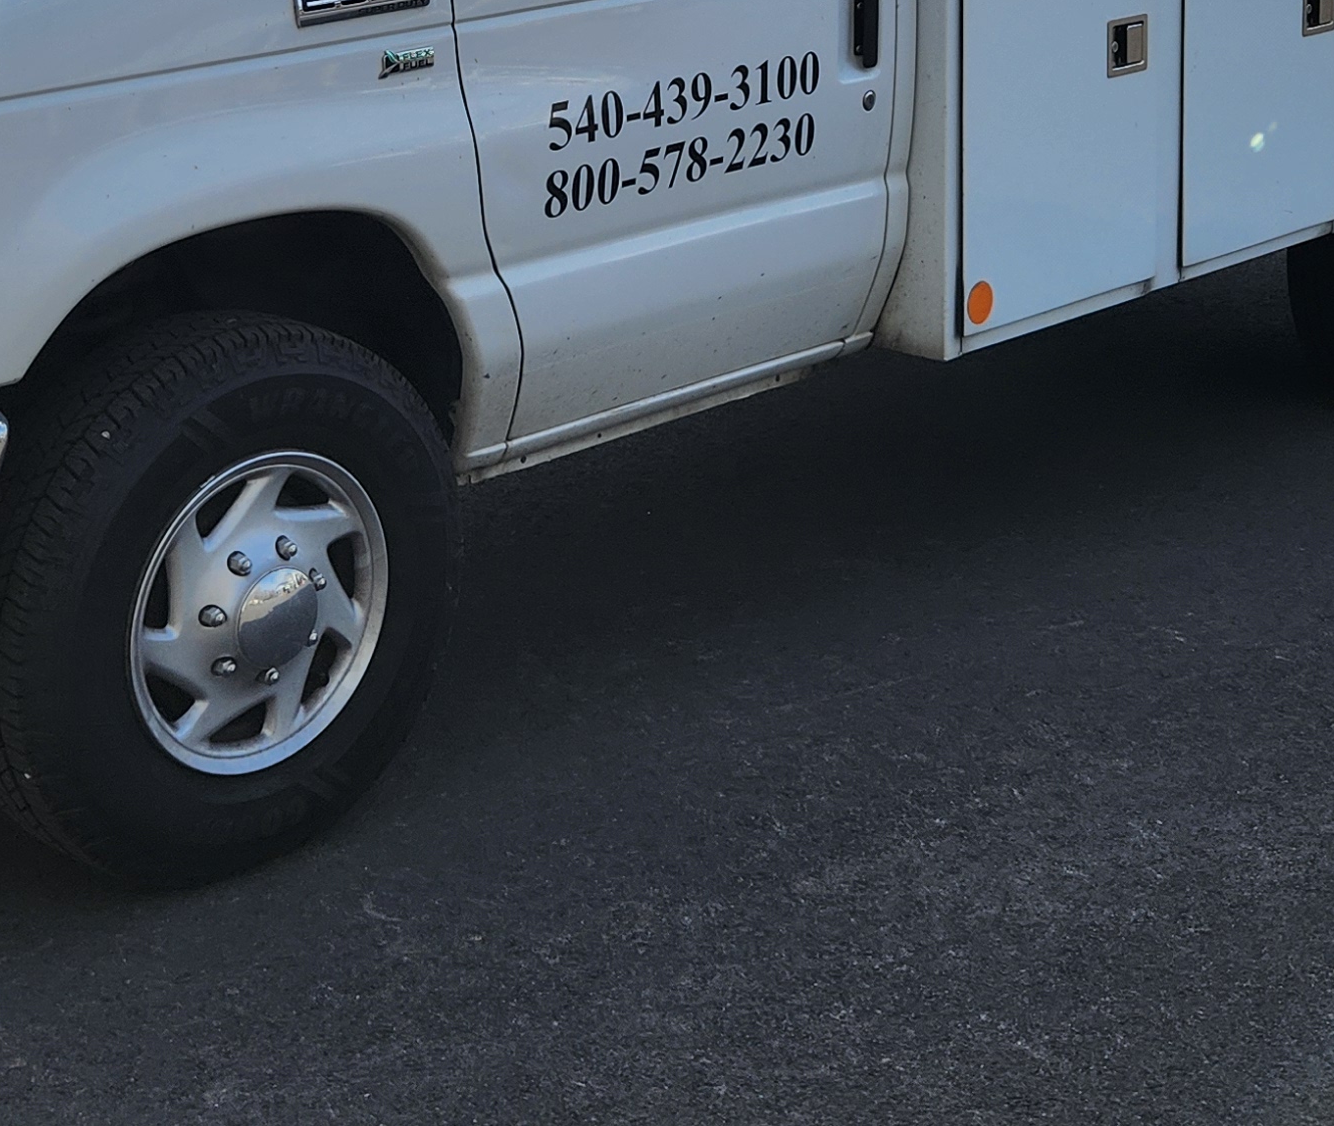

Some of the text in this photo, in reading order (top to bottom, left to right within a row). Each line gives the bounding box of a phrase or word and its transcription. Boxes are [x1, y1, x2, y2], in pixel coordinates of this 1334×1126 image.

[402, 48, 433, 62] FLEX
[402, 58, 434, 71] FUEL
[548, 51, 820, 152] 540-439-3100
[544, 112, 815, 219] 800-578-2230
